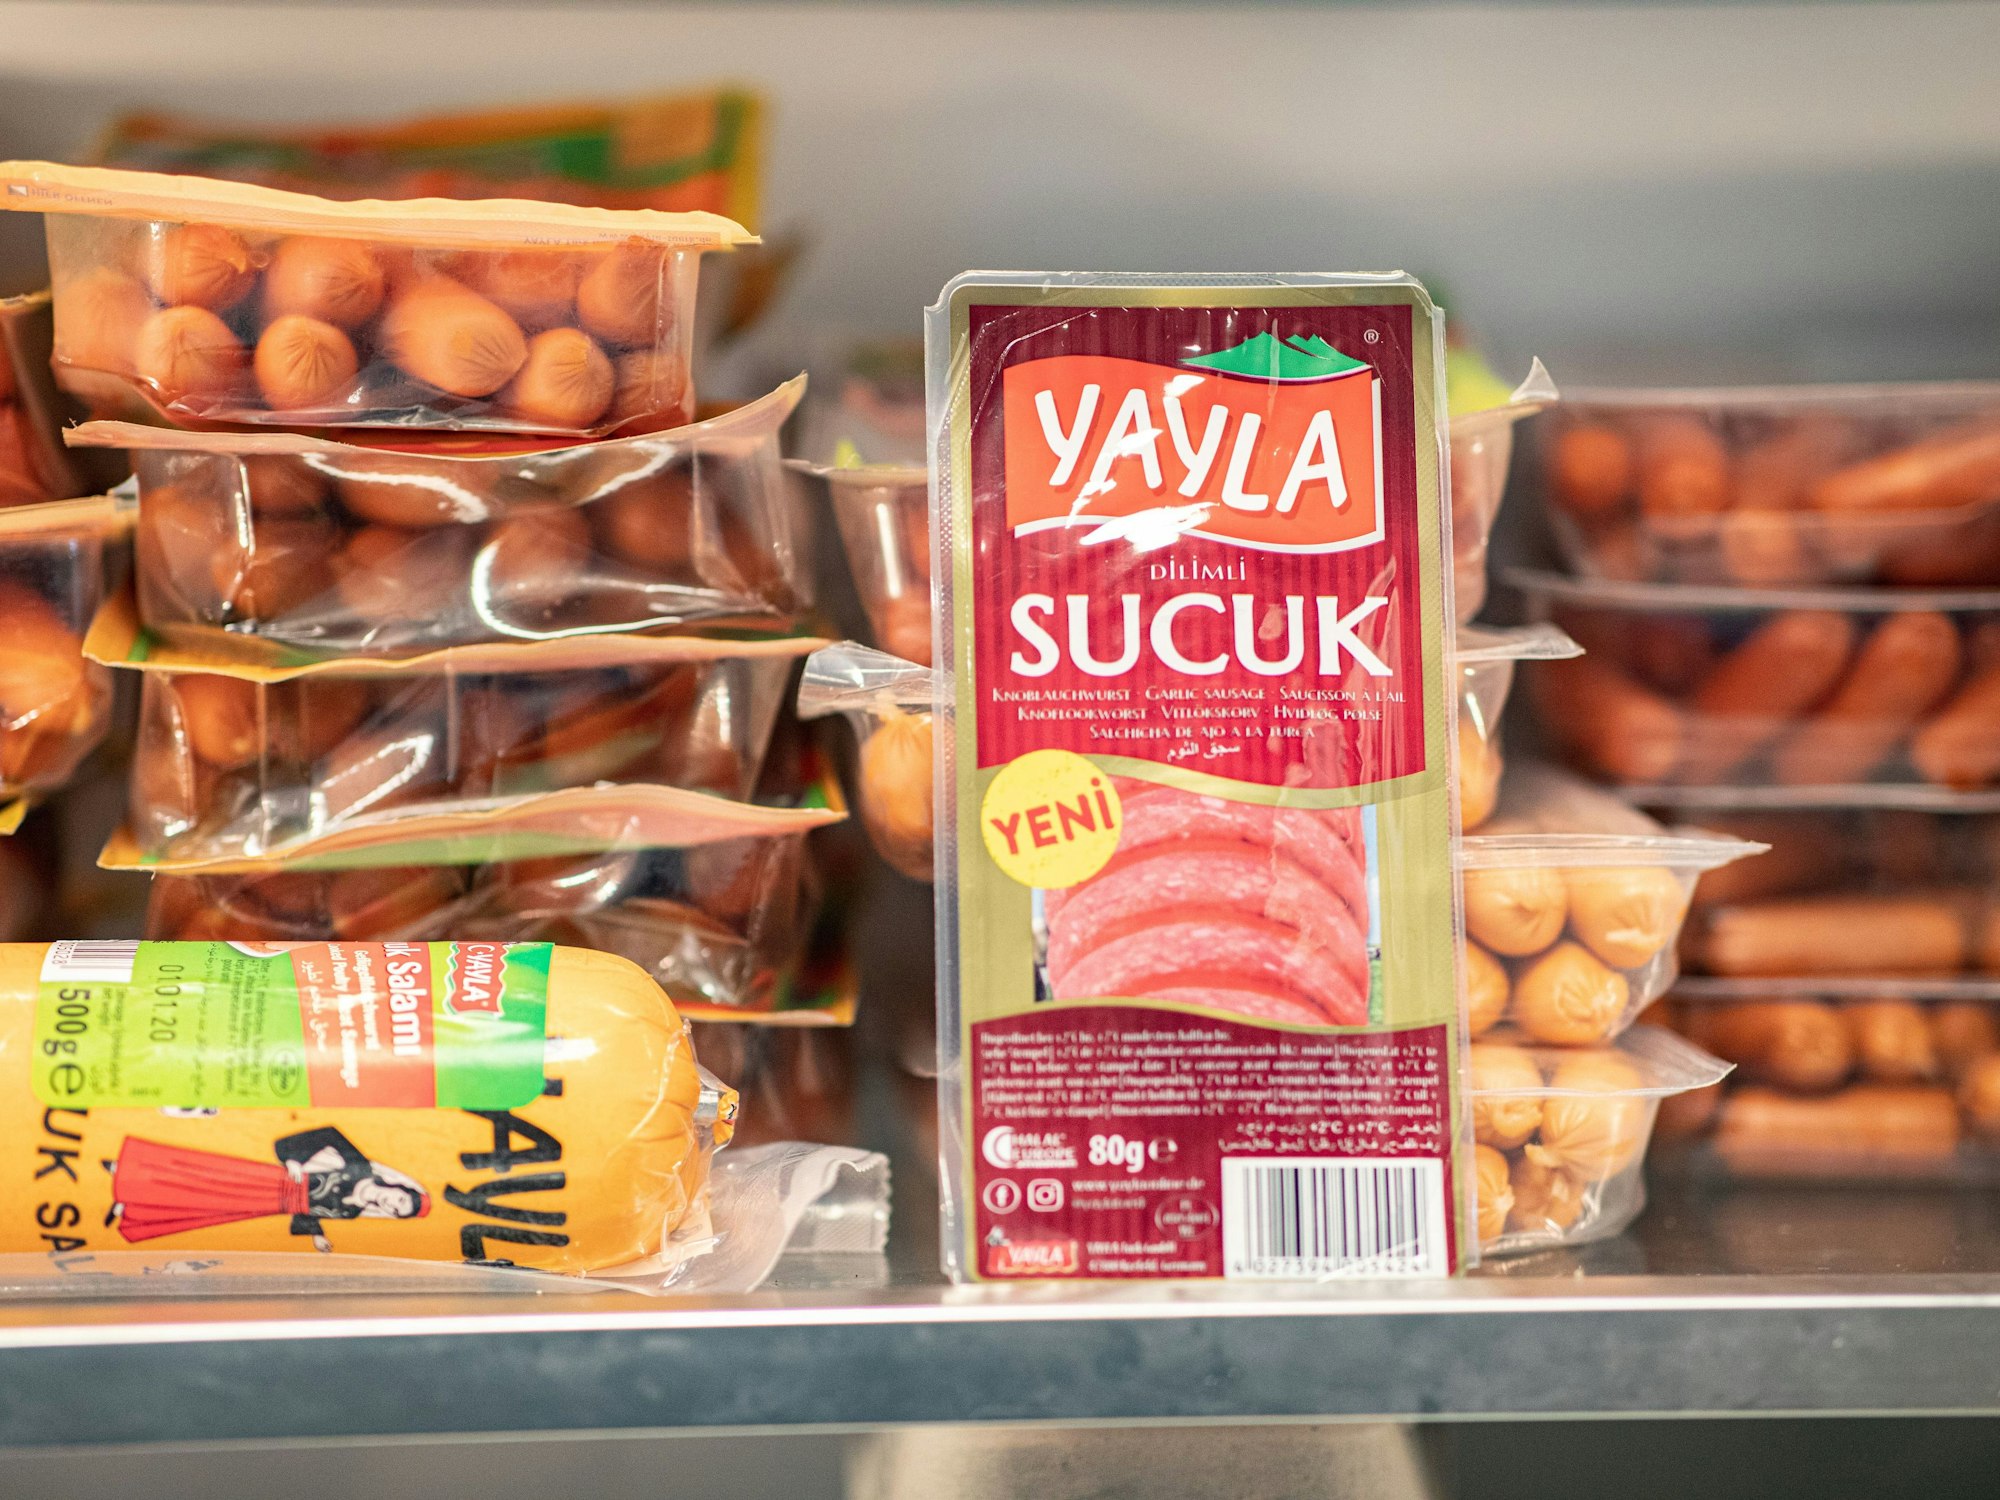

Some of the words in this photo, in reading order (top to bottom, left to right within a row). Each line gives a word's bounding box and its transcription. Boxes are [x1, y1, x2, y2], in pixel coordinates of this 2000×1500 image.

[1034, 383, 1348, 513] YAYLA
[1150, 555, 1246, 581] DİLİMLİ
[1009, 593, 1393, 677] SUCUK
[1145, 686, 1199, 701] GARLIC
[1204, 688, 1265, 700] SAUSAGE
[1279, 685, 1356, 702] SAUCISSON
[1089, 724, 1171, 739] SALCHICHA
[1176, 726, 1192, 737] DE
[1200, 726, 1225, 739] AJO
[1231, 726, 1241, 738] A
[1246, 727, 1263, 738] LA
[1203, 742, 1241, 759] سجق
[991, 776, 1115, 856] YENİ
[461, 953, 494, 1002] YAYLA
[1088, 1134, 1145, 1173] 80g
